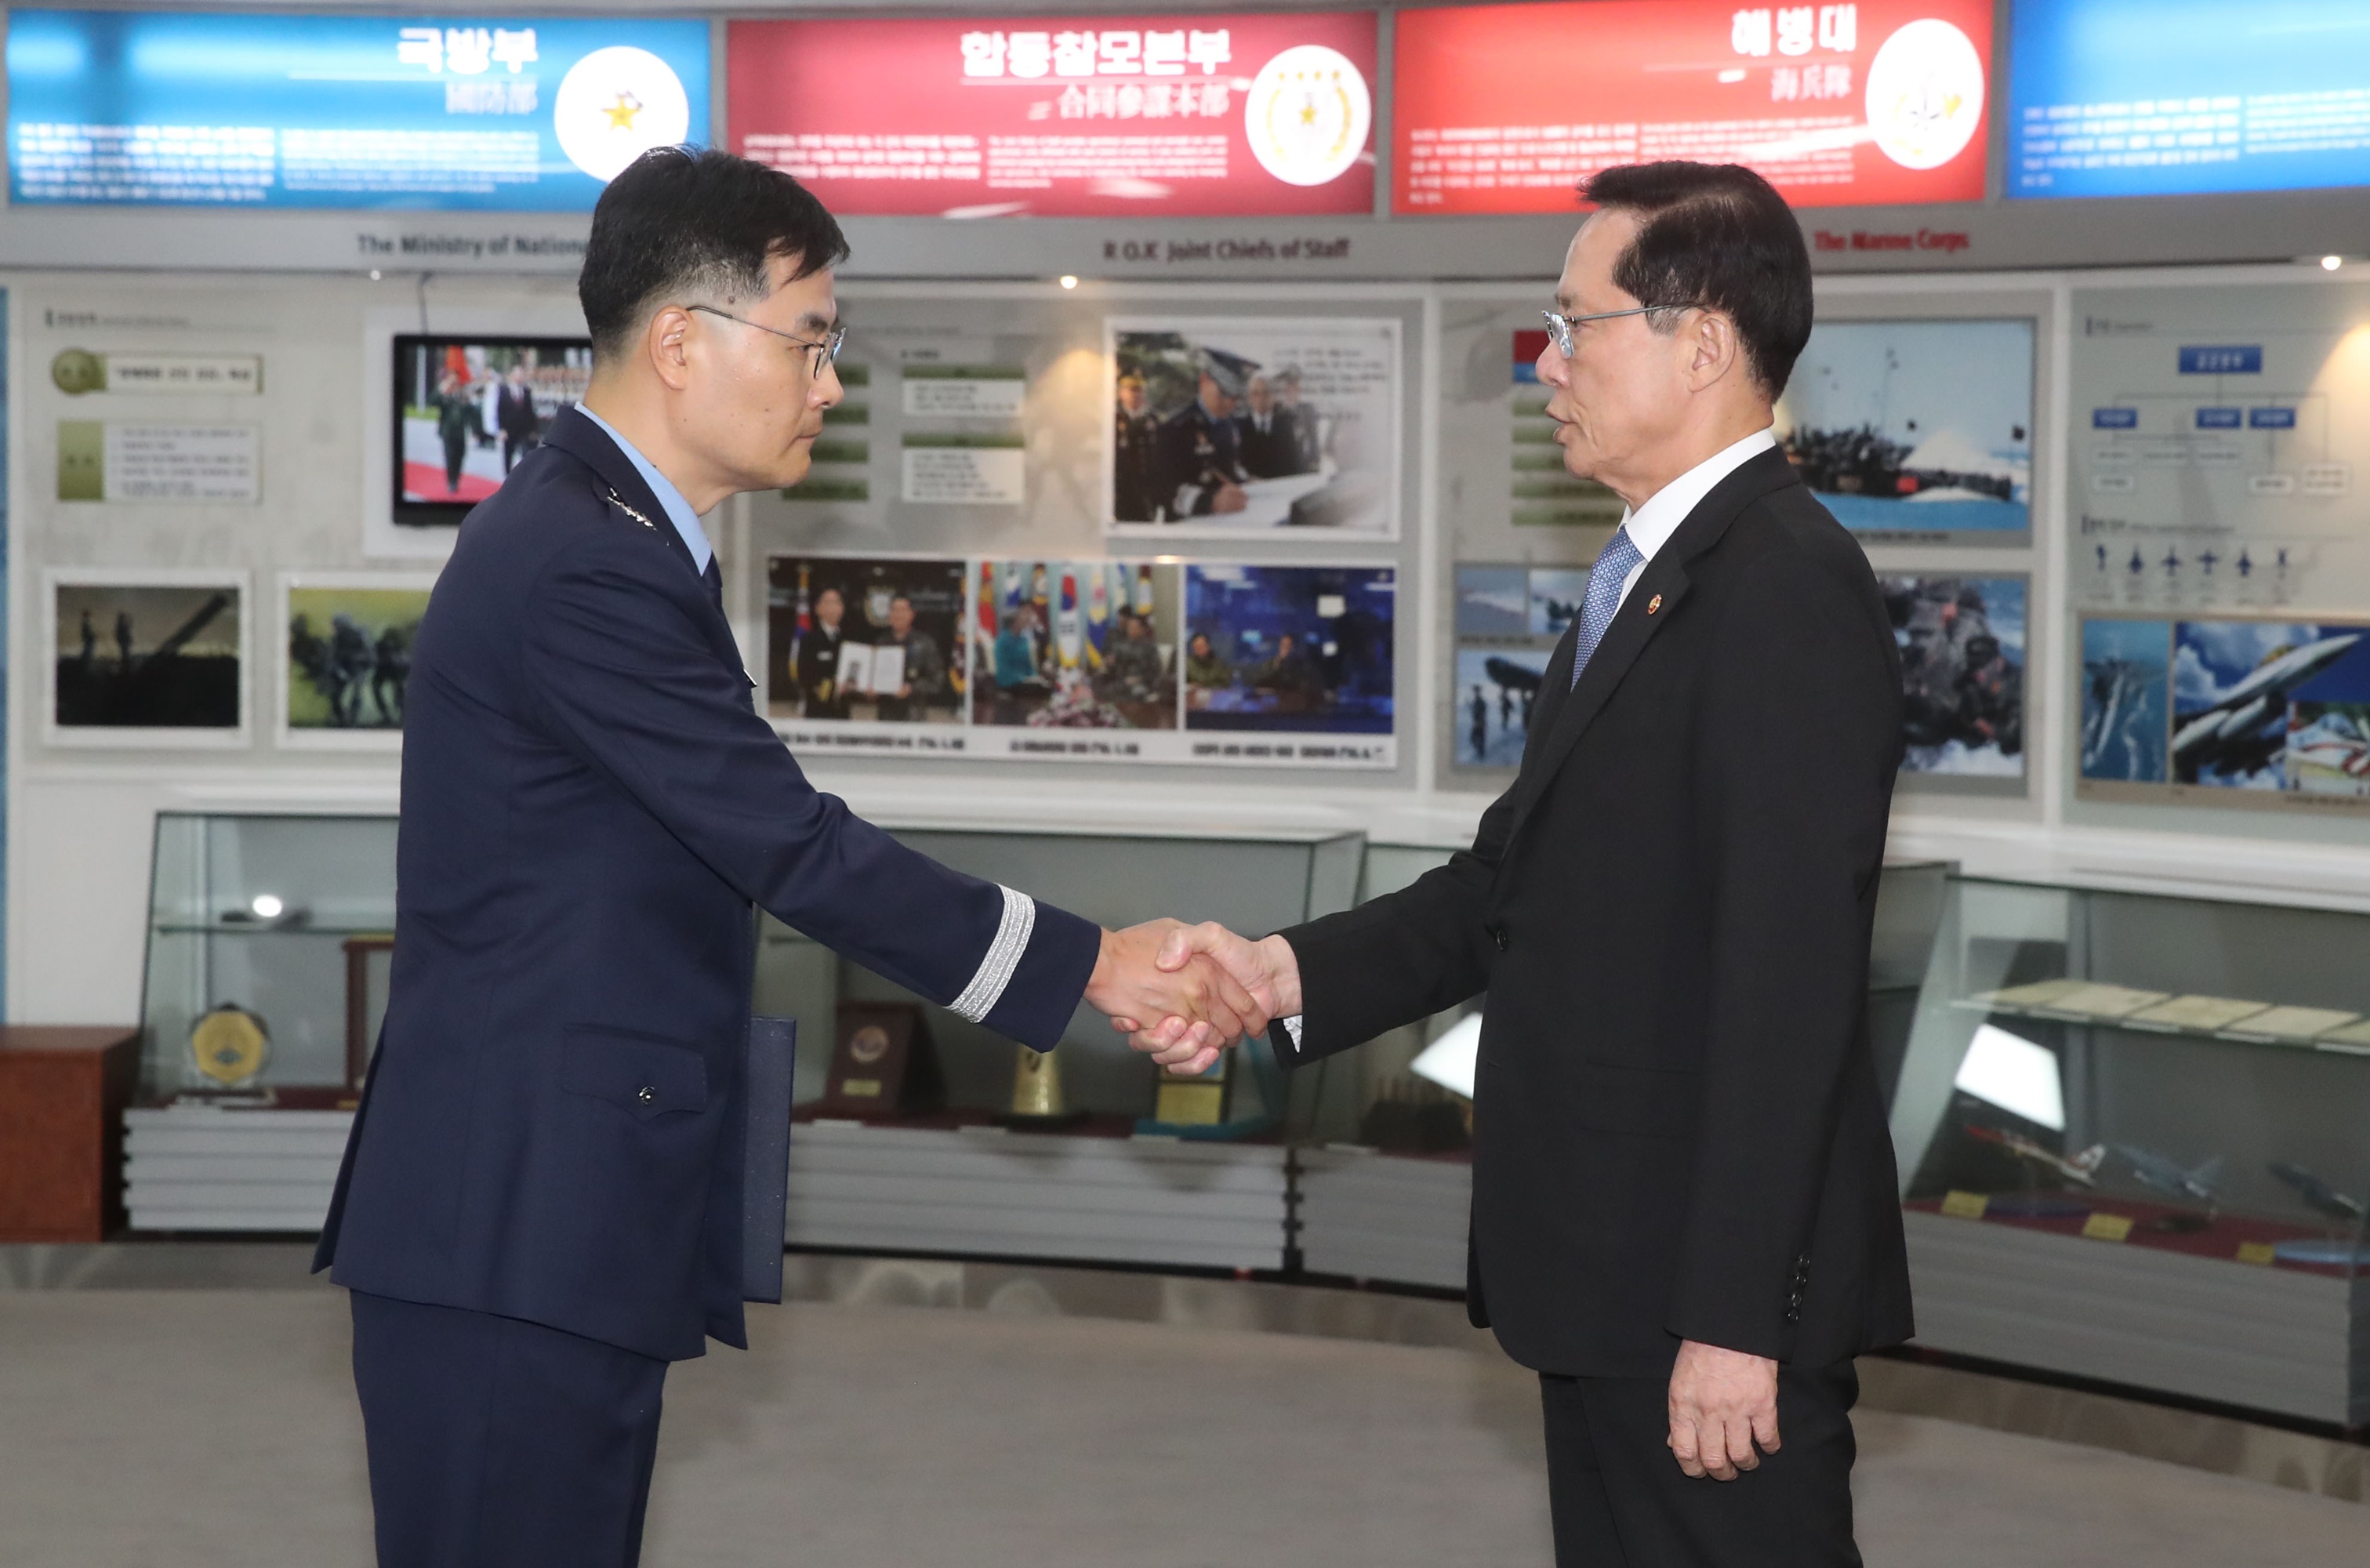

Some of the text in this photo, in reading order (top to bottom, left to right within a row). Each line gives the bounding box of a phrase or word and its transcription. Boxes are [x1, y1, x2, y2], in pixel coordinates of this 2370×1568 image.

[1731, 3, 1856, 56] 해병대
[397, 27, 539, 74] 국방부
[960, 30, 1231, 78] 합동참모본부
[357, 234, 590, 260] The Ministry of Nationa
[1167, 239, 1210, 263] Joint
[1217, 238, 1274, 260] Chiefs
[1280, 239, 1299, 259] of
[1305, 238, 1349, 259] Staff
[1814, 230, 1846, 250] The
[1918, 228, 1969, 252] Corps
